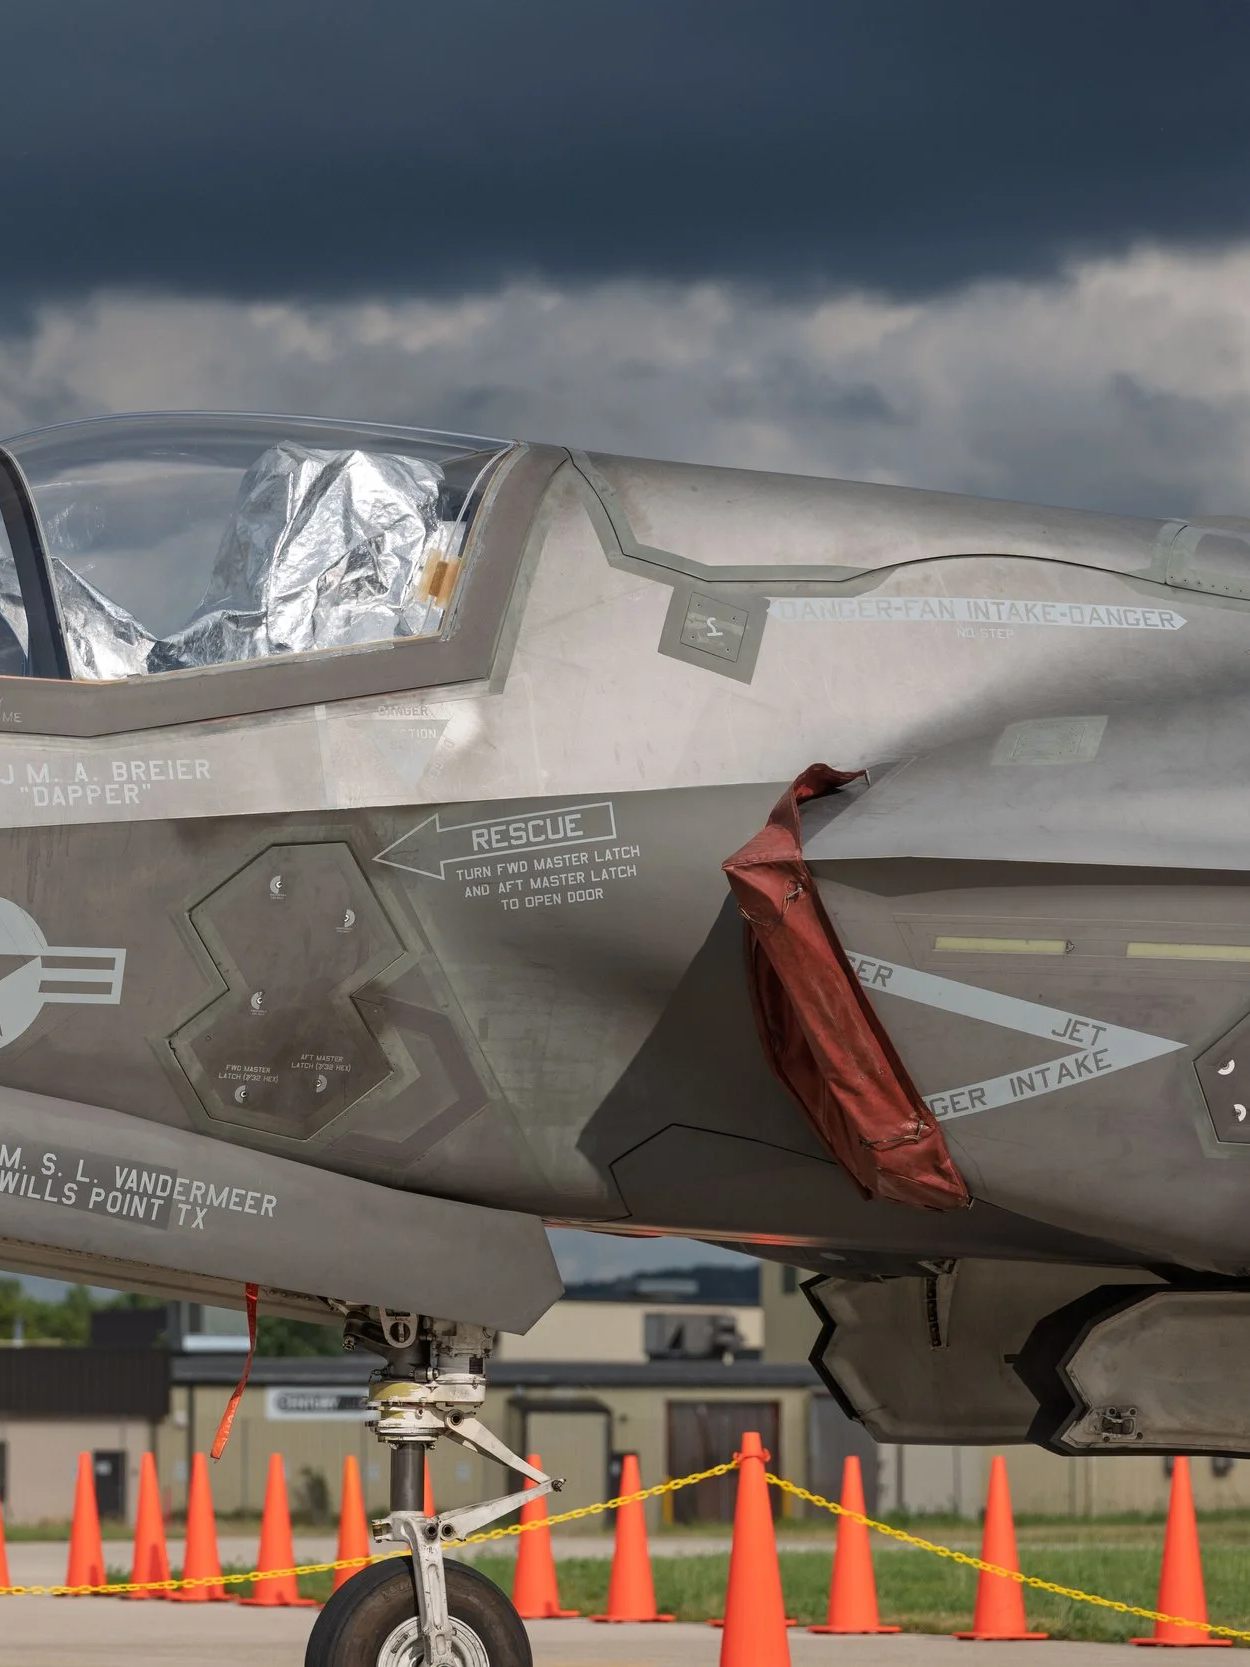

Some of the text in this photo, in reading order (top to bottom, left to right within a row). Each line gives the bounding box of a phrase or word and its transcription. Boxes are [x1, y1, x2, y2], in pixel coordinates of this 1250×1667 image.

[957, 627, 1014, 639] NO STEP
[111, 759, 212, 782] BREIER
[20, 783, 151, 807] "DAPPER"
[471, 813, 584, 851] RESCUE
[456, 845, 640, 881] TURN FWD MASTER LATCH
[465, 864, 637, 898] AND AFT MASTER LATCH
[501, 888, 604, 911] TO OPEN DOOR
[1051, 1017, 1108, 1047] JET
[226, 1064, 271, 1074] FWD MASTER
[291, 1062, 314, 1070] LATCH
[301, 1053, 344, 1063] AFT MASTER
[218, 1072, 241, 1081] LATCH
[1009, 1048, 1112, 1098] INTAKE
[40, 1152, 63, 1177] S.
[75, 1159, 99, 1184] L.
[114, 1165, 278, 1218] VANDERMEER
[88, 1187, 164, 1222] POINT
[177, 1203, 209, 1230] TX
